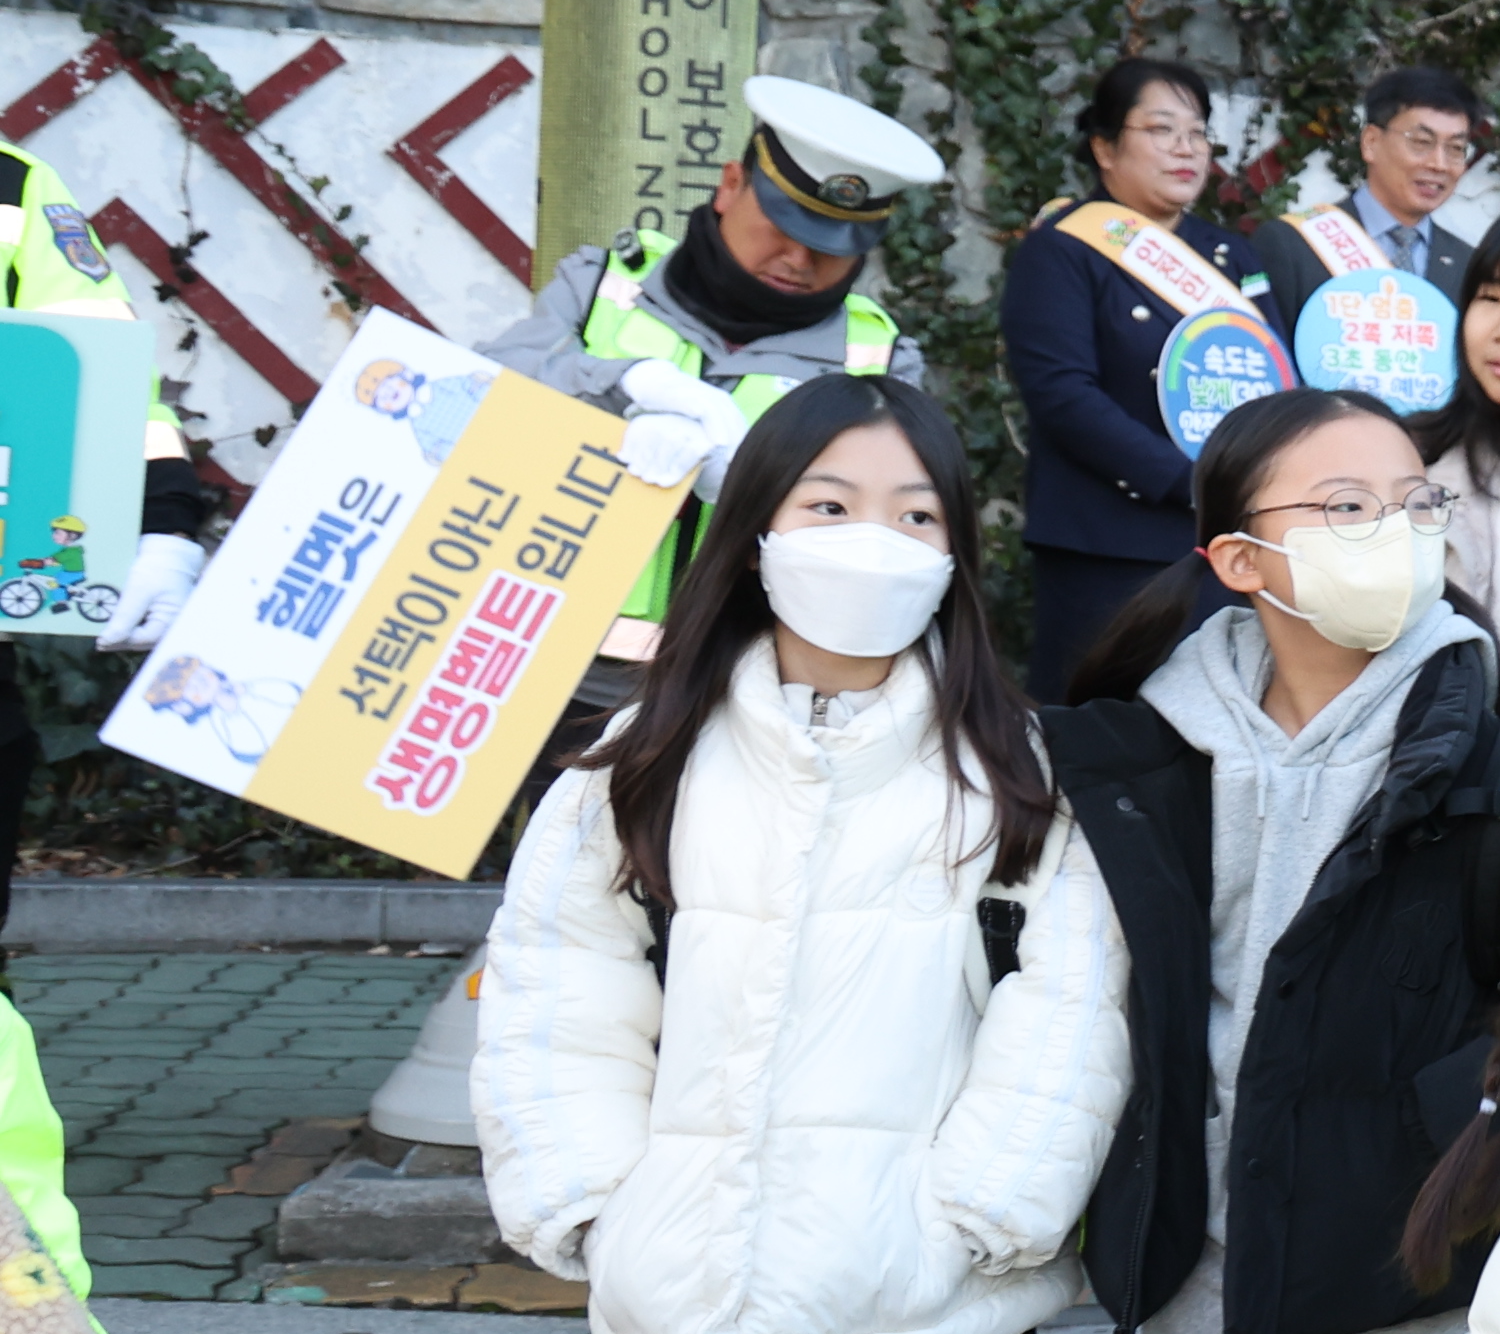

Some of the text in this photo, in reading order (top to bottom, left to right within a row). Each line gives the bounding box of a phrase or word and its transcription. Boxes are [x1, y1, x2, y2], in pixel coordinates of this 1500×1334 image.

[1204, 344, 1267, 378] 속도는
[339, 475, 521, 722] 선택이 아닌
